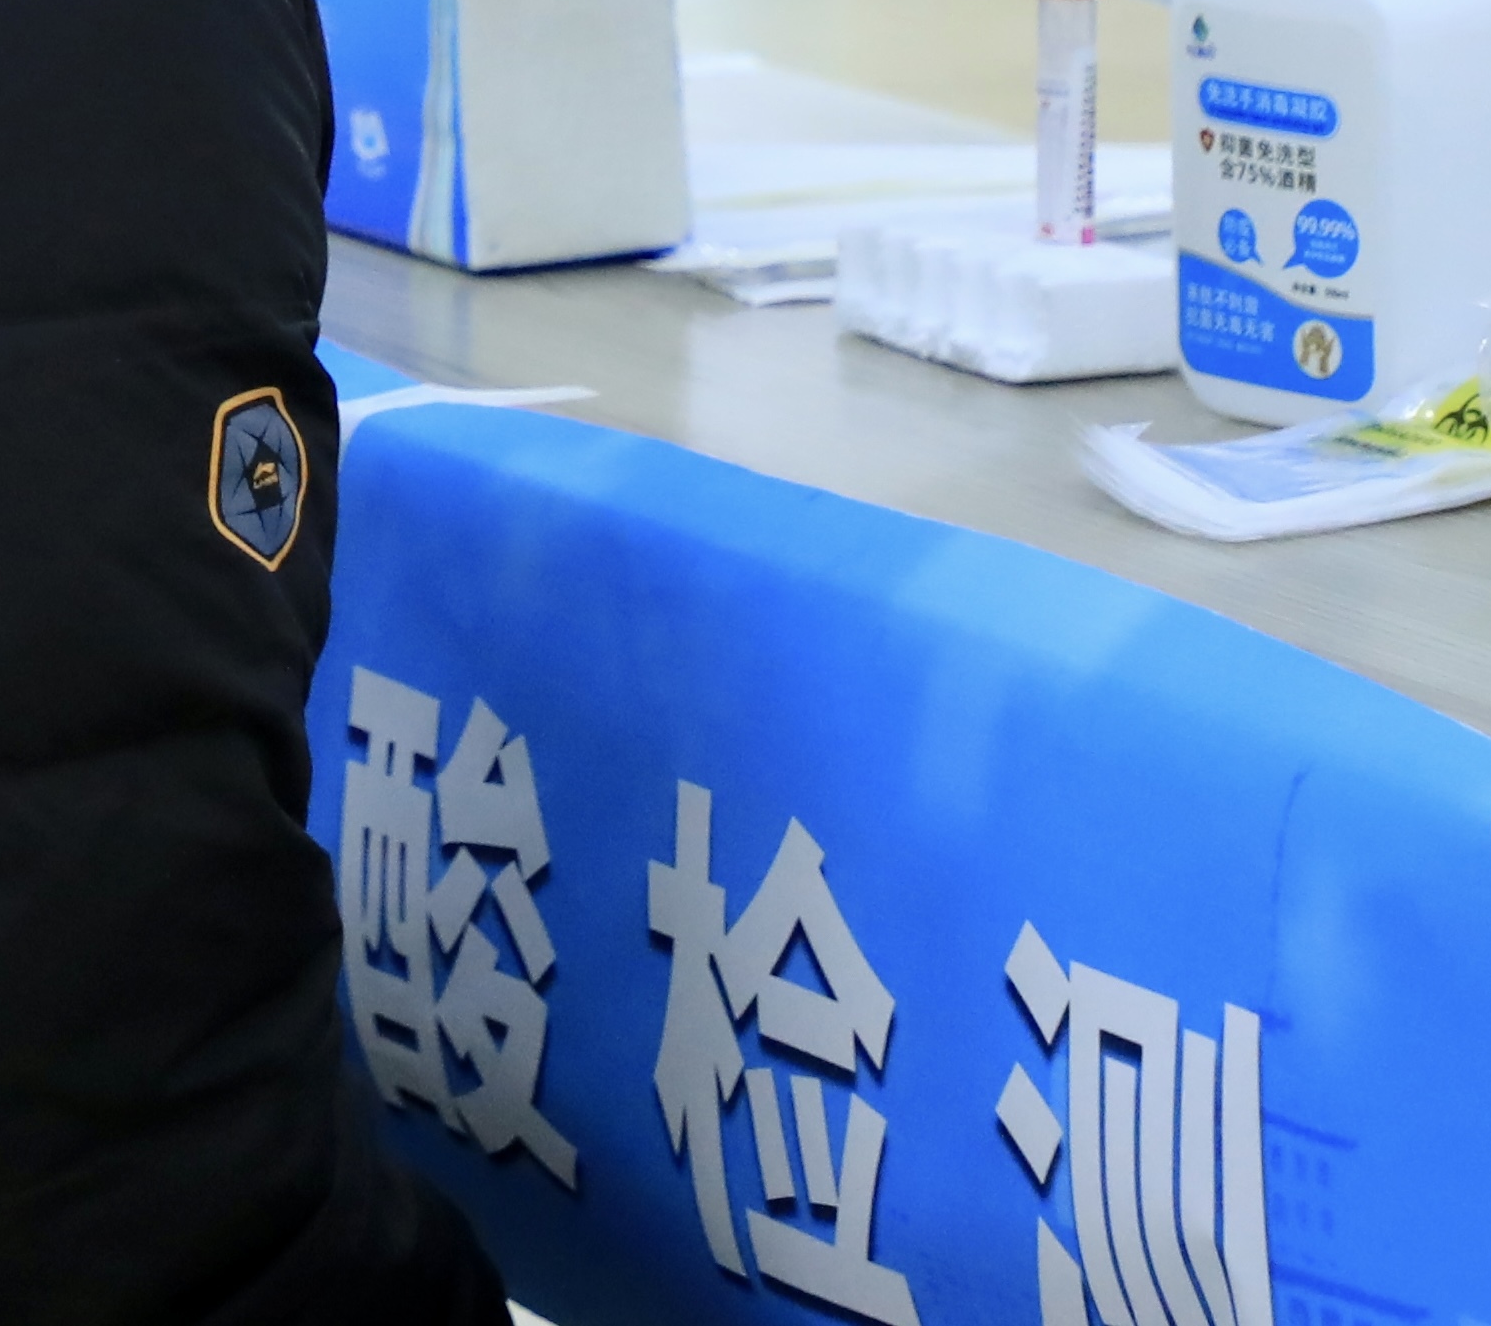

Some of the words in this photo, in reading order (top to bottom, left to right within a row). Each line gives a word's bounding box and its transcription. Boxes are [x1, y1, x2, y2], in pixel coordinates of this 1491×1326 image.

[1220, 157, 1316, 193] 含75%酒精
[1296, 215, 1356, 240] 99.99%
[340, 664, 1274, 1326] 酸检测
